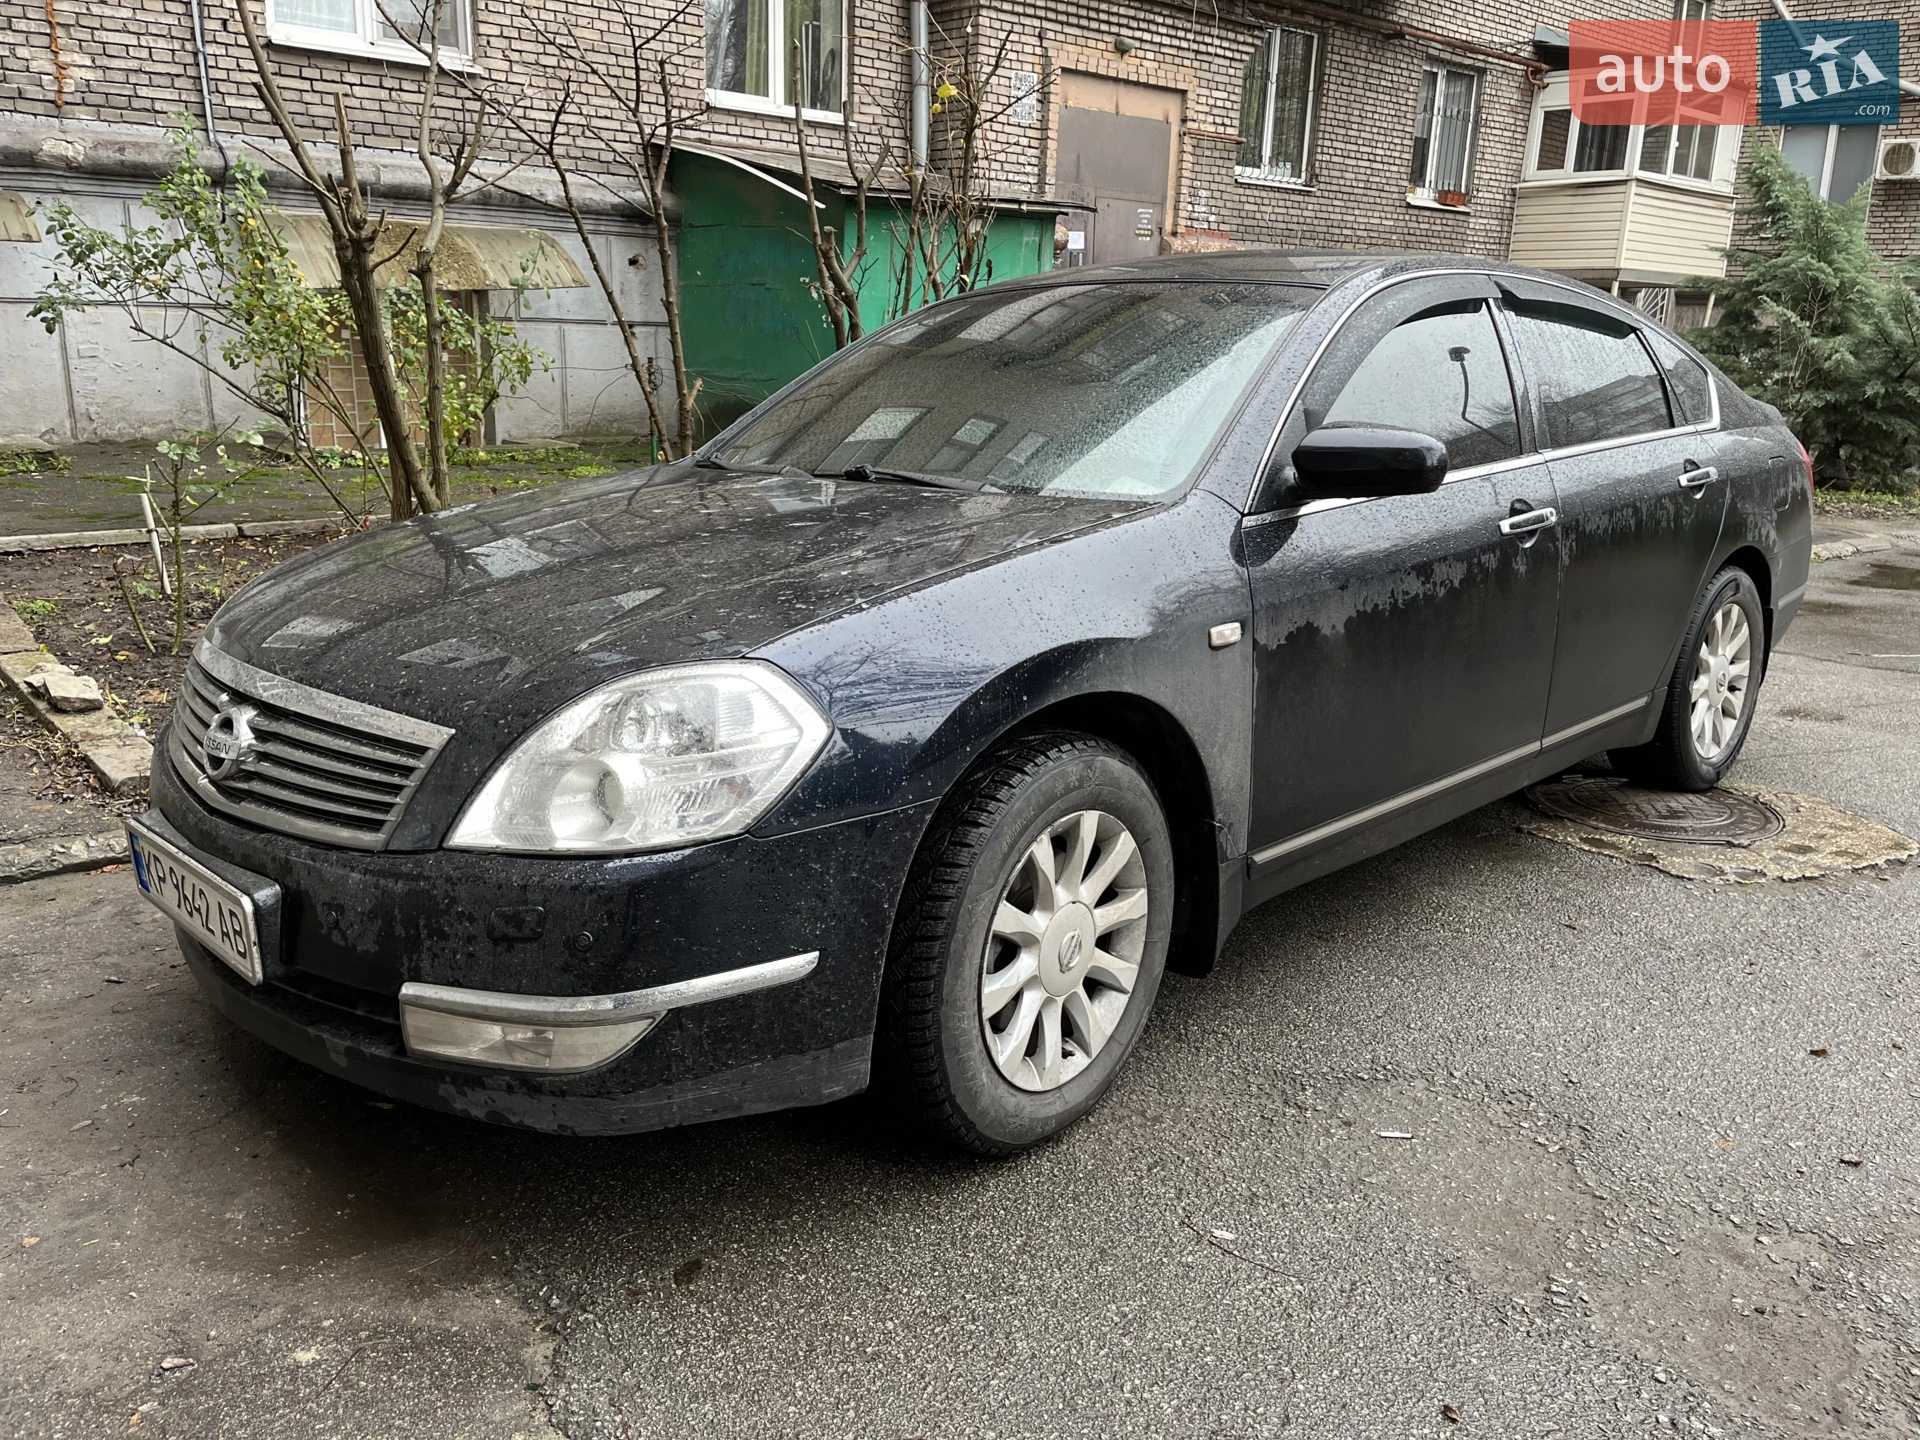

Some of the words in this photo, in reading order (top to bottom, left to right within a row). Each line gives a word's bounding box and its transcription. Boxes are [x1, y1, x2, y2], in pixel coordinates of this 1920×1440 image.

[141, 845, 166, 897] KP
[169, 866, 215, 937] 9642
[217, 900, 248, 960] AB
